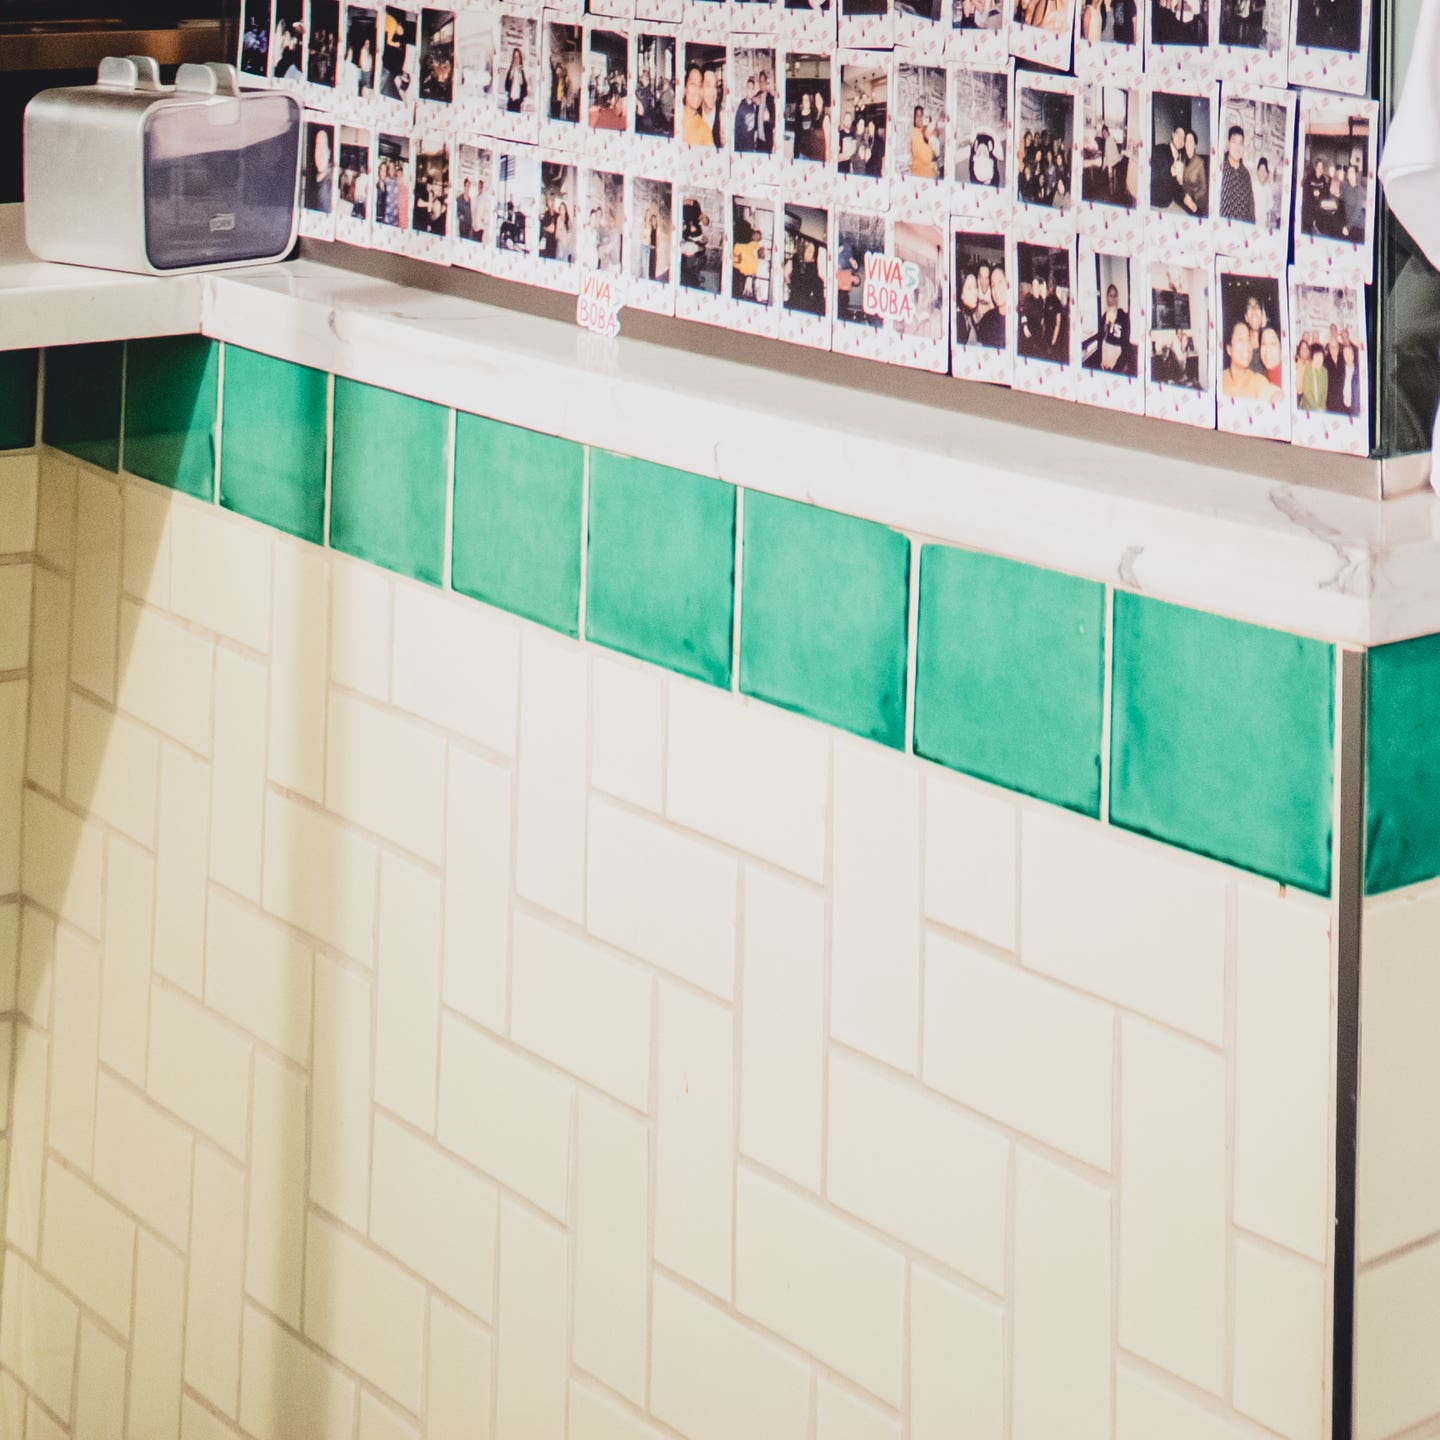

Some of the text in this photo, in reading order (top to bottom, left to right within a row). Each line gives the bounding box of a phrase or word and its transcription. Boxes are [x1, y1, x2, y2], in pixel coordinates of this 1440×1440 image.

[867, 256, 903, 289] VIVA
[583, 275, 612, 307] VIVA
[866, 283, 912, 319] BOBA
[580, 298, 617, 335] BOBA
